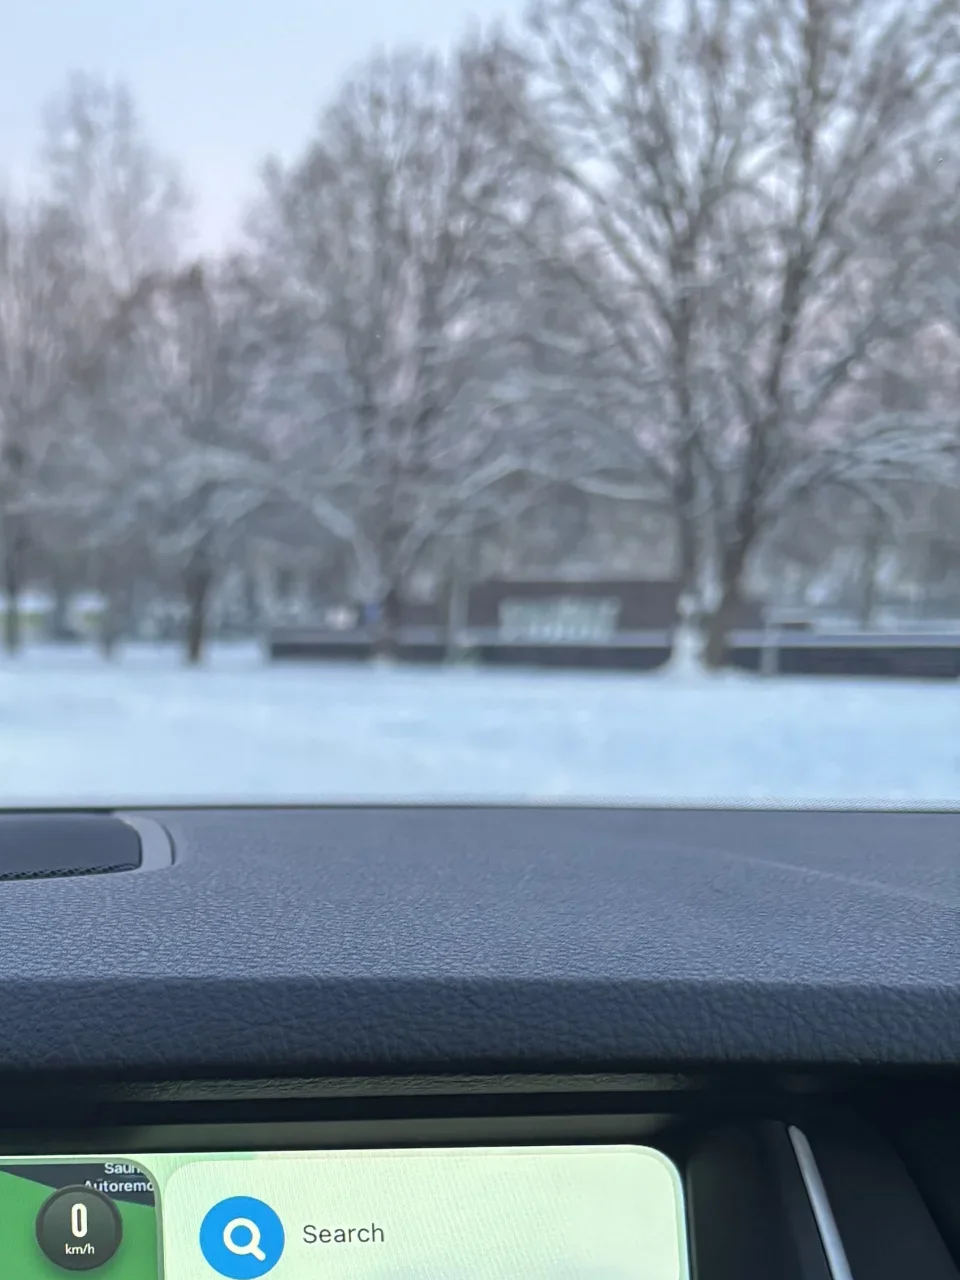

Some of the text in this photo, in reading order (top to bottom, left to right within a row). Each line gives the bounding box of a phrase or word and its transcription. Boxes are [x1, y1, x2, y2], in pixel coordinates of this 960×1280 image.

[71, 1202, 88, 1238] 0
[302, 1222, 385, 1244] Search
[65, 1242, 95, 1255] km/h
